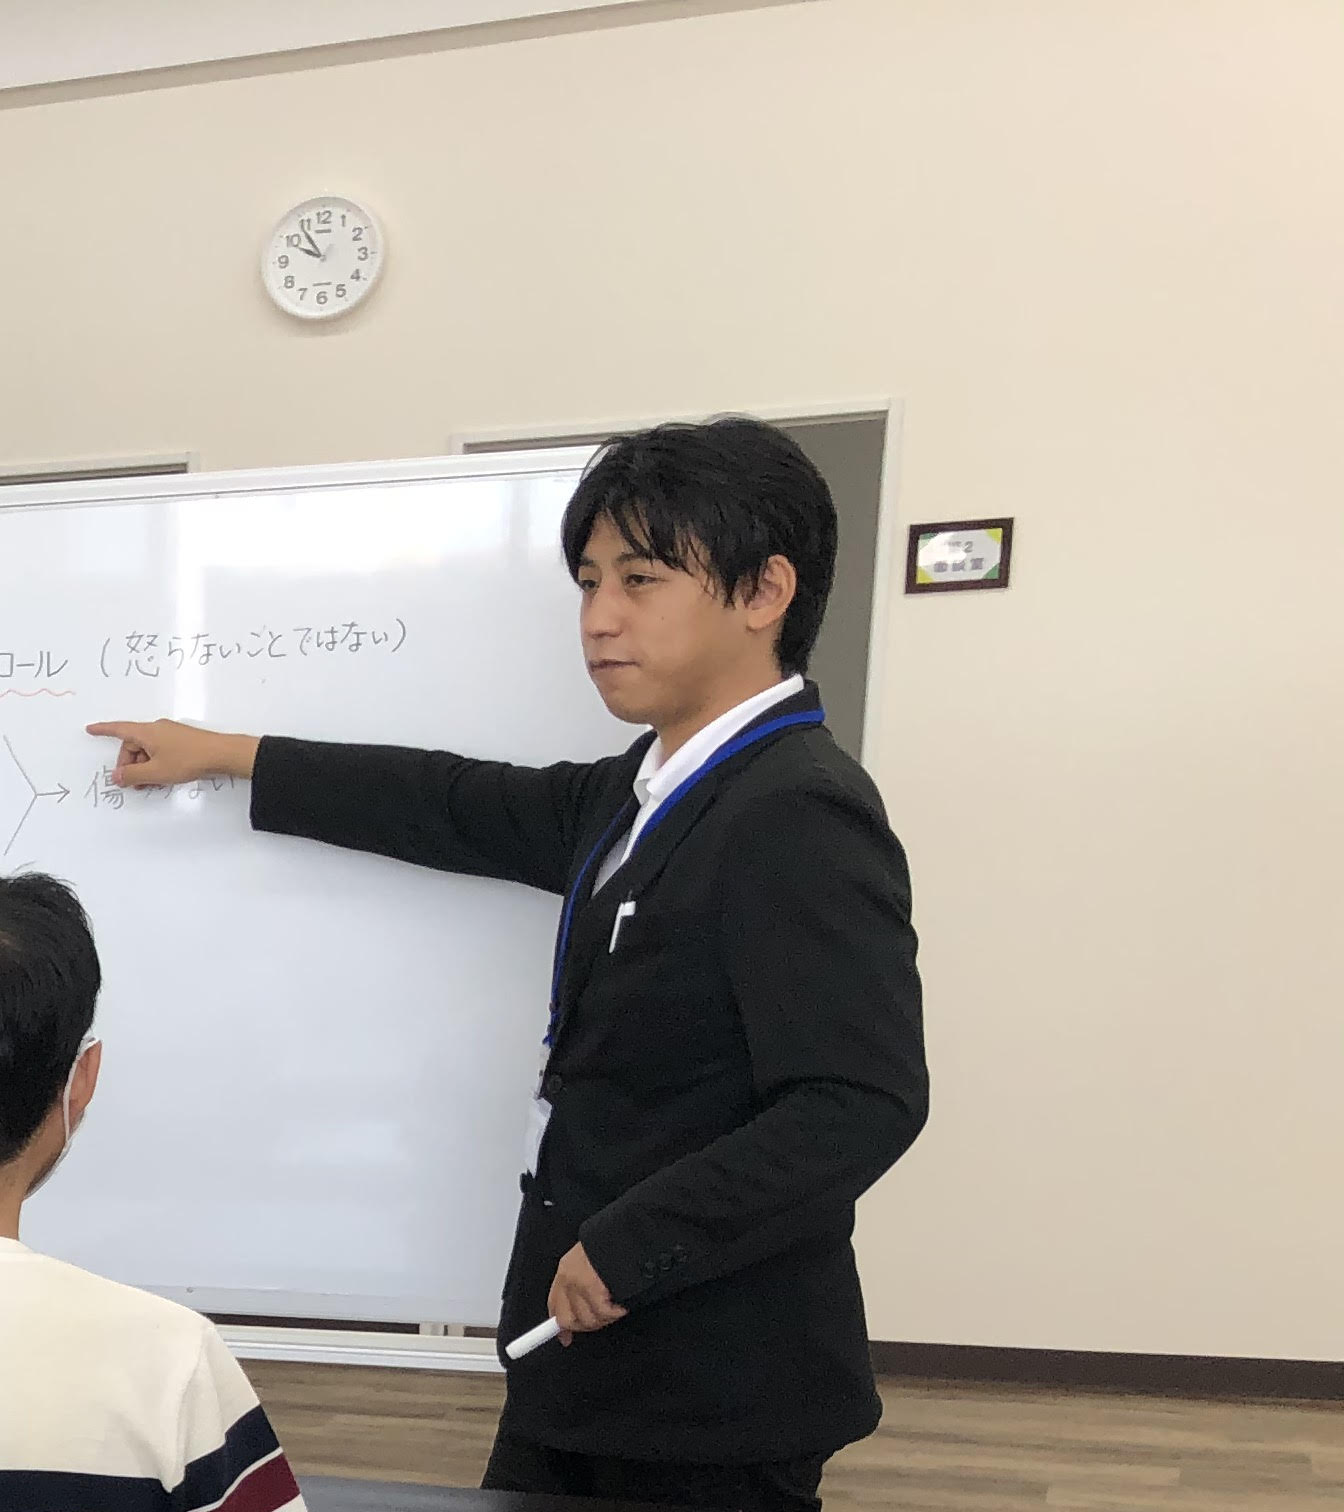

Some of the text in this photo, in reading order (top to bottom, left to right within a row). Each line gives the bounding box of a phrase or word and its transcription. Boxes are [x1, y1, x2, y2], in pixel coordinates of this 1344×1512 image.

[299, 218, 311, 231] 11
[316, 210, 332, 225] 12
[341, 214, 347, 227] 1
[285, 233, 301, 247] 10
[352, 227, 362, 241] 2
[357, 246, 368, 261] 3
[278, 254, 289, 269] 9
[350, 268, 361, 281] 4
[284, 275, 295, 289] 8
[297, 287, 307, 300] 7
[335, 283, 346, 298] 5
[316, 291, 328, 305] 6
